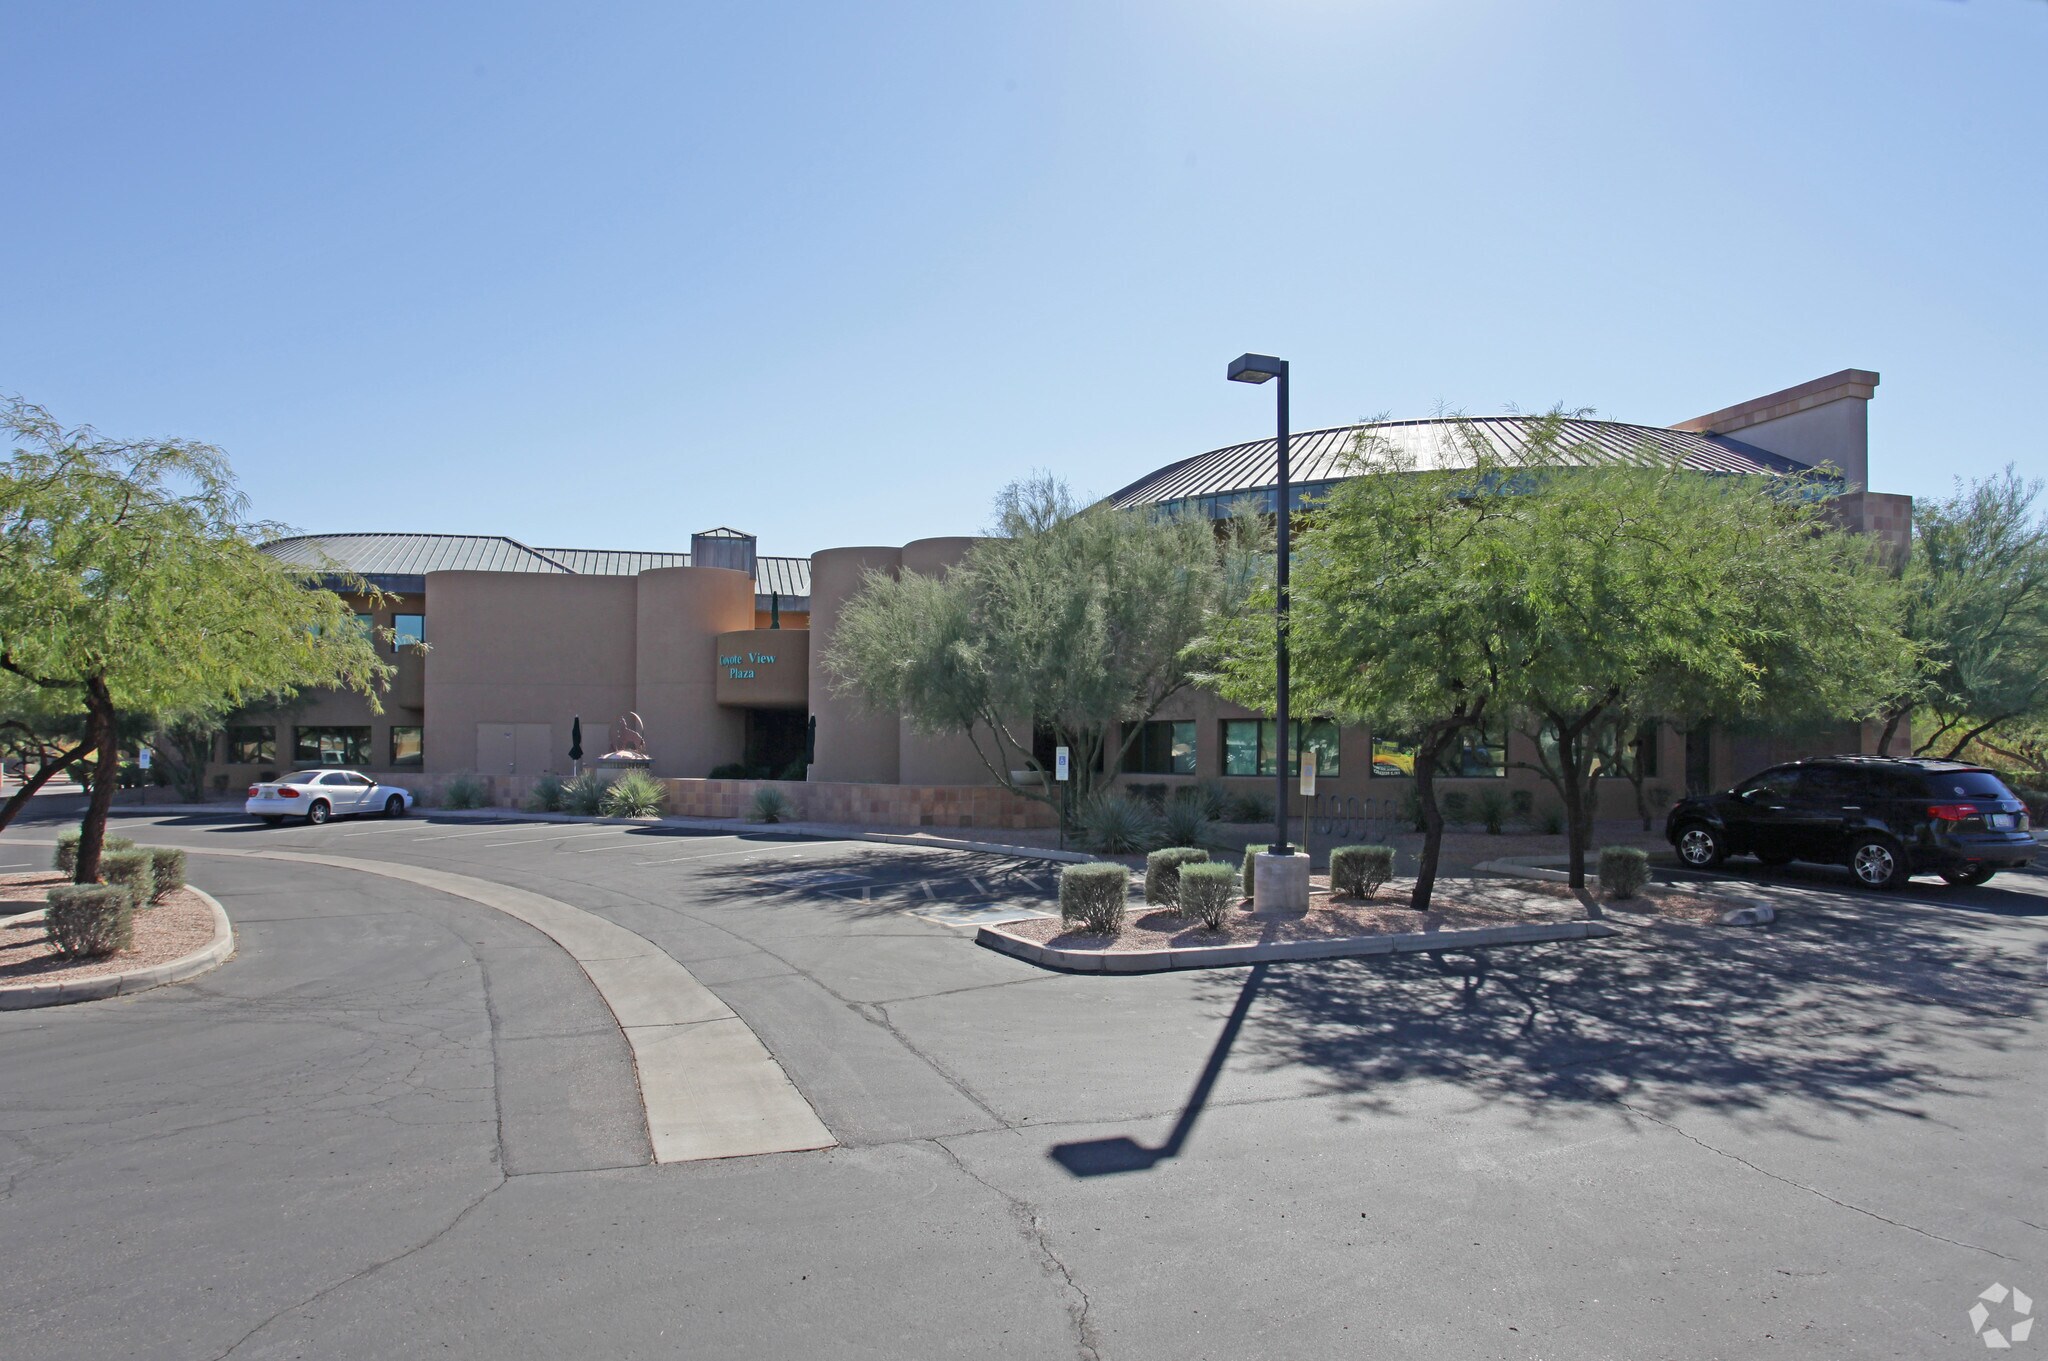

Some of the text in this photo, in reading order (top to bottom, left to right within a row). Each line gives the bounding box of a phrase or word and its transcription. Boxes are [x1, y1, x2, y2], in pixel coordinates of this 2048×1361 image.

[720, 652, 776, 667] Coyote View
[730, 667, 755, 679] Plaza
